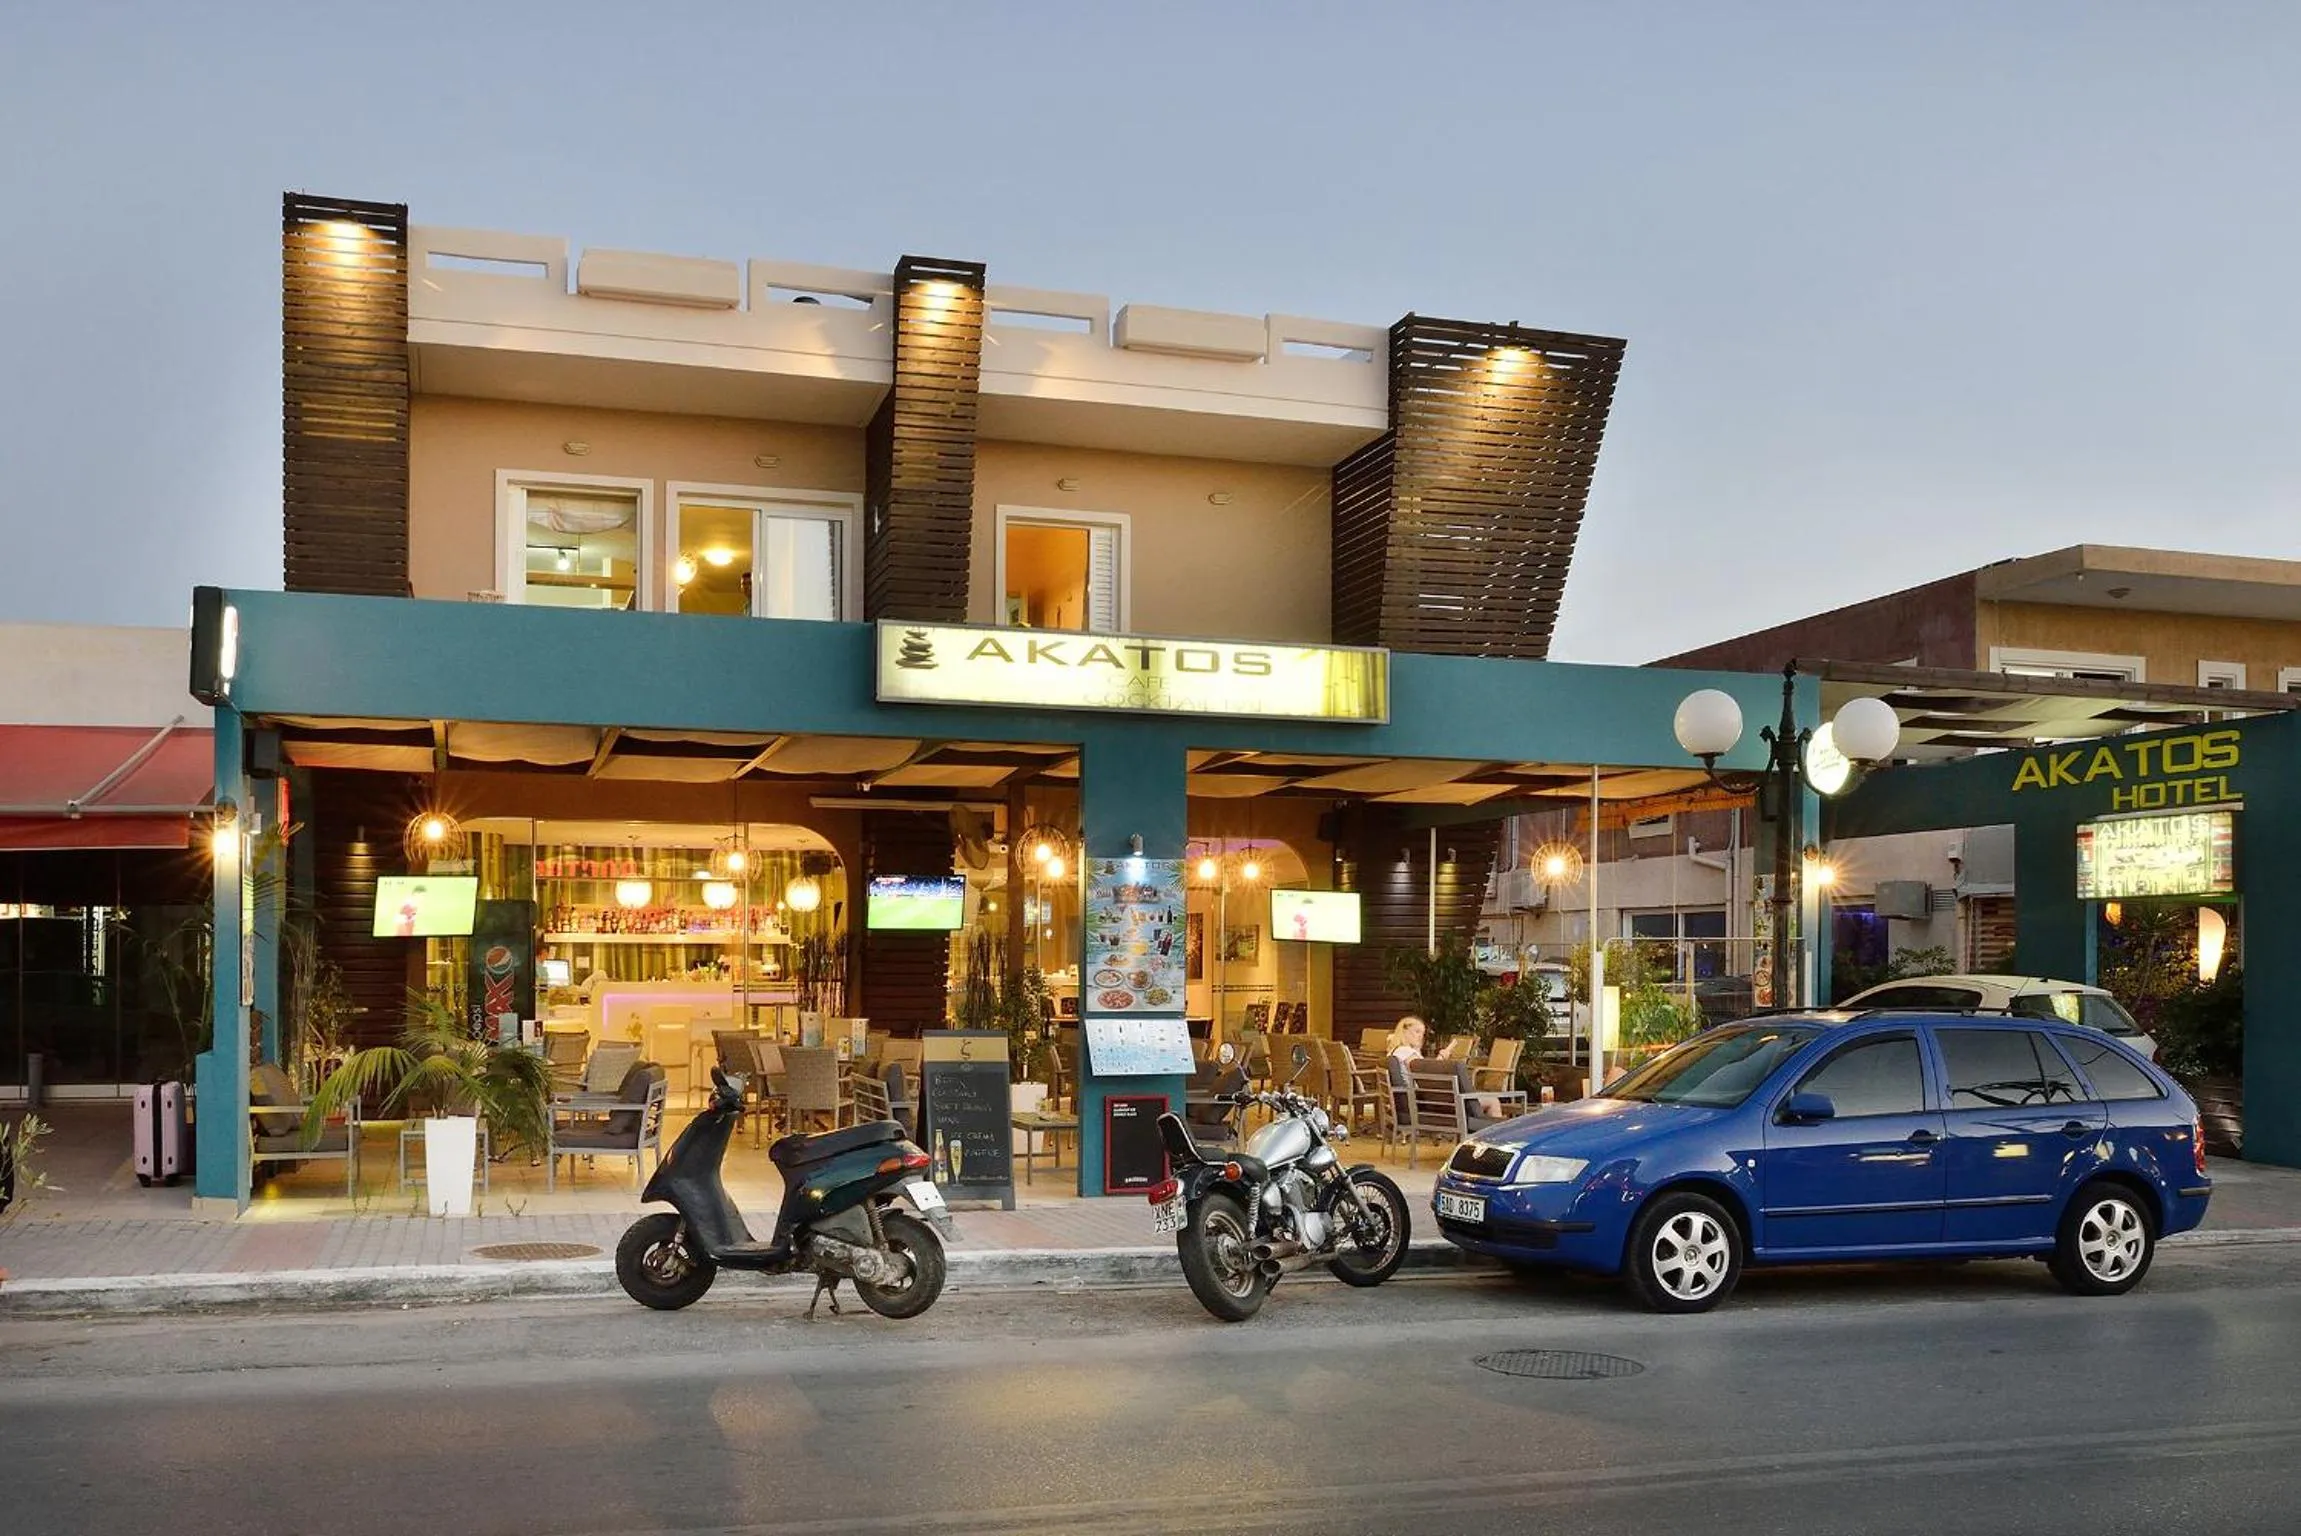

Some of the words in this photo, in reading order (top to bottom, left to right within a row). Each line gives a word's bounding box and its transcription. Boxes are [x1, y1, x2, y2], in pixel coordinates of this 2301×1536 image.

[966, 637, 1273, 676] AKATOS
[2011, 729, 2242, 792] AKATOS
[2112, 775, 2243, 810] HOTEL
[2098, 815, 2209, 839] AKATOS
[1459, 1200, 1480, 1218] 8375
